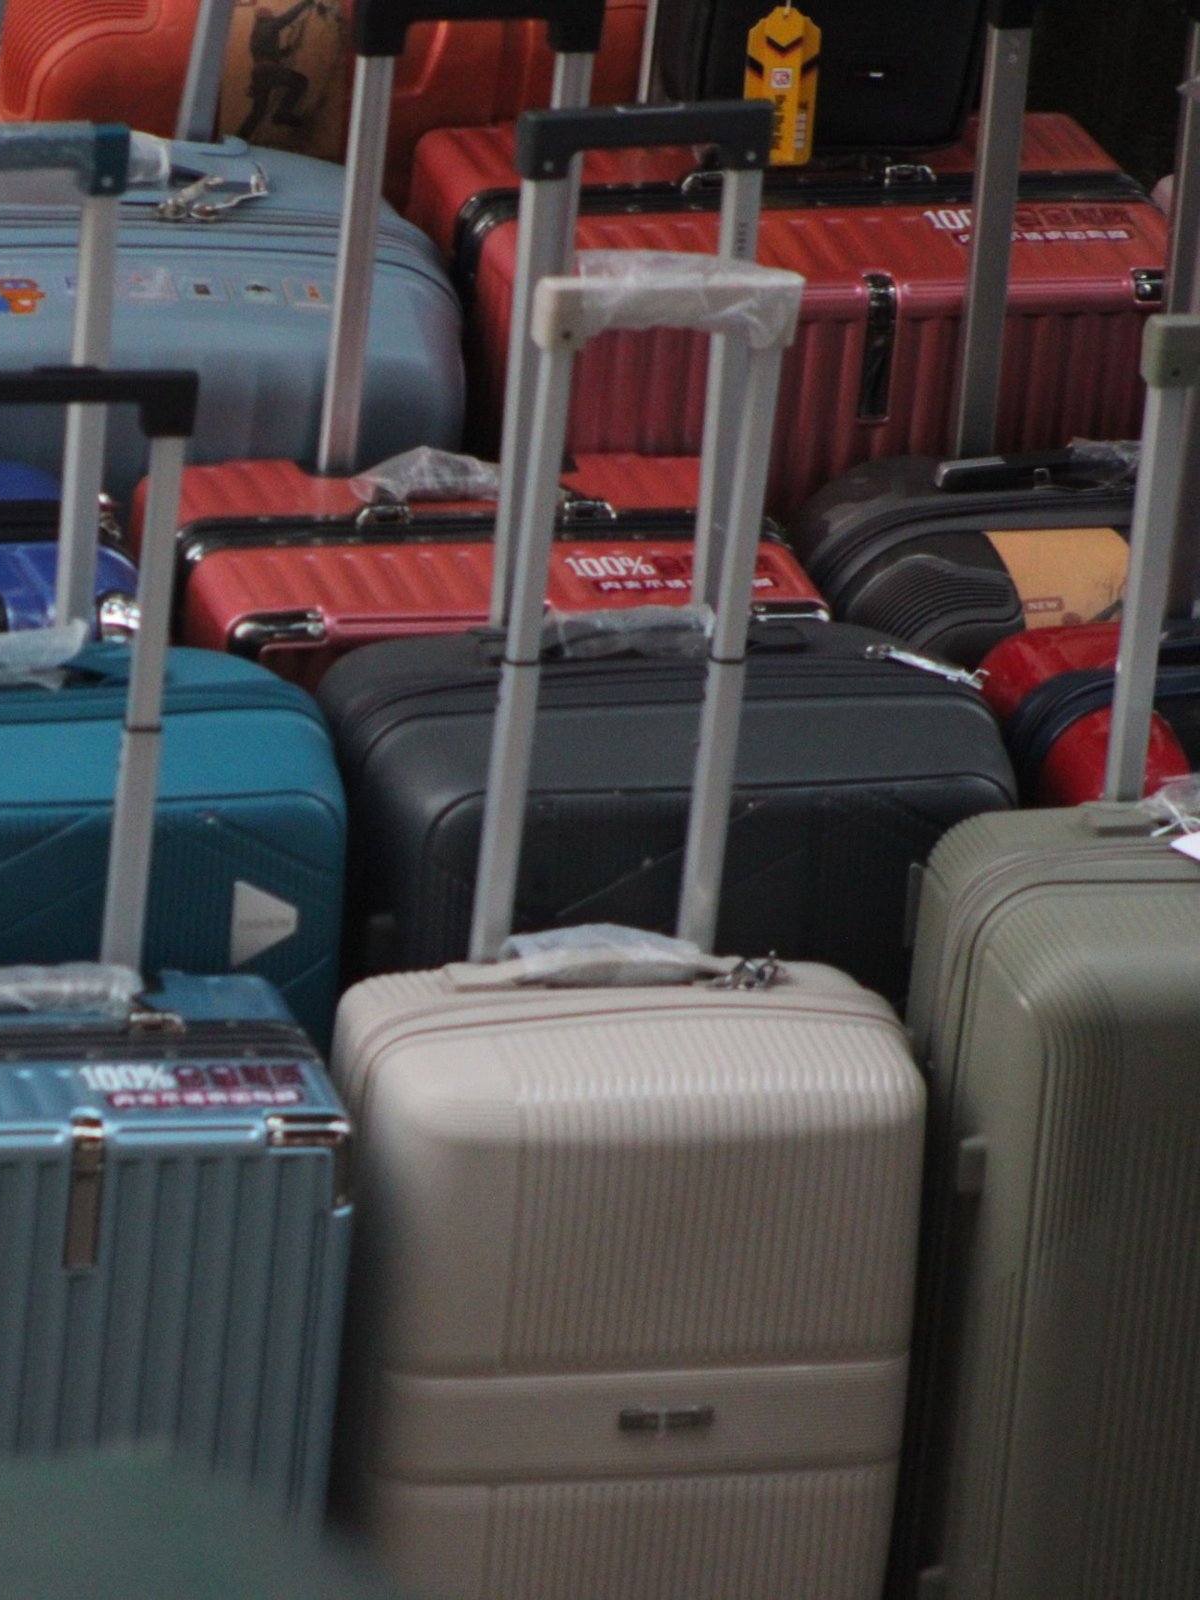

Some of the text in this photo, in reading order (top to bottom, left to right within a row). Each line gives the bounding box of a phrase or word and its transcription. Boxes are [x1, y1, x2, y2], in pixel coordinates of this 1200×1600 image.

[564, 556, 657, 578] 100%
[1027, 601, 1058, 611] NEW
[79, 1064, 178, 1091] 100%
